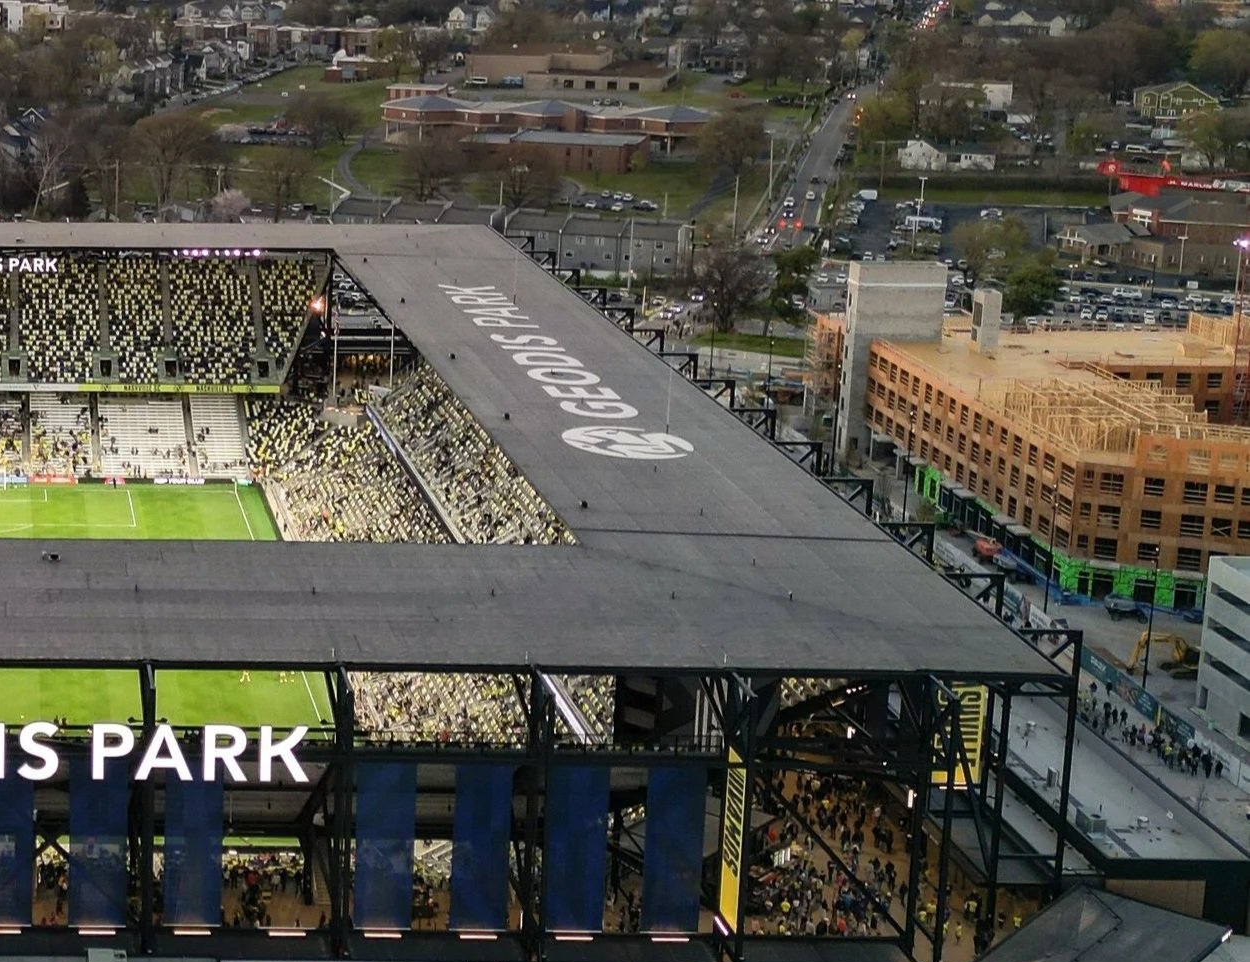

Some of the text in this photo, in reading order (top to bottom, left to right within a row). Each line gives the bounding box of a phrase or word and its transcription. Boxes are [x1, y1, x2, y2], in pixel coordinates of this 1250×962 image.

[8, 257, 58, 273] PARK
[437, 283, 639, 419] GEODIS PARK
[91, 723, 310, 783] PARK
